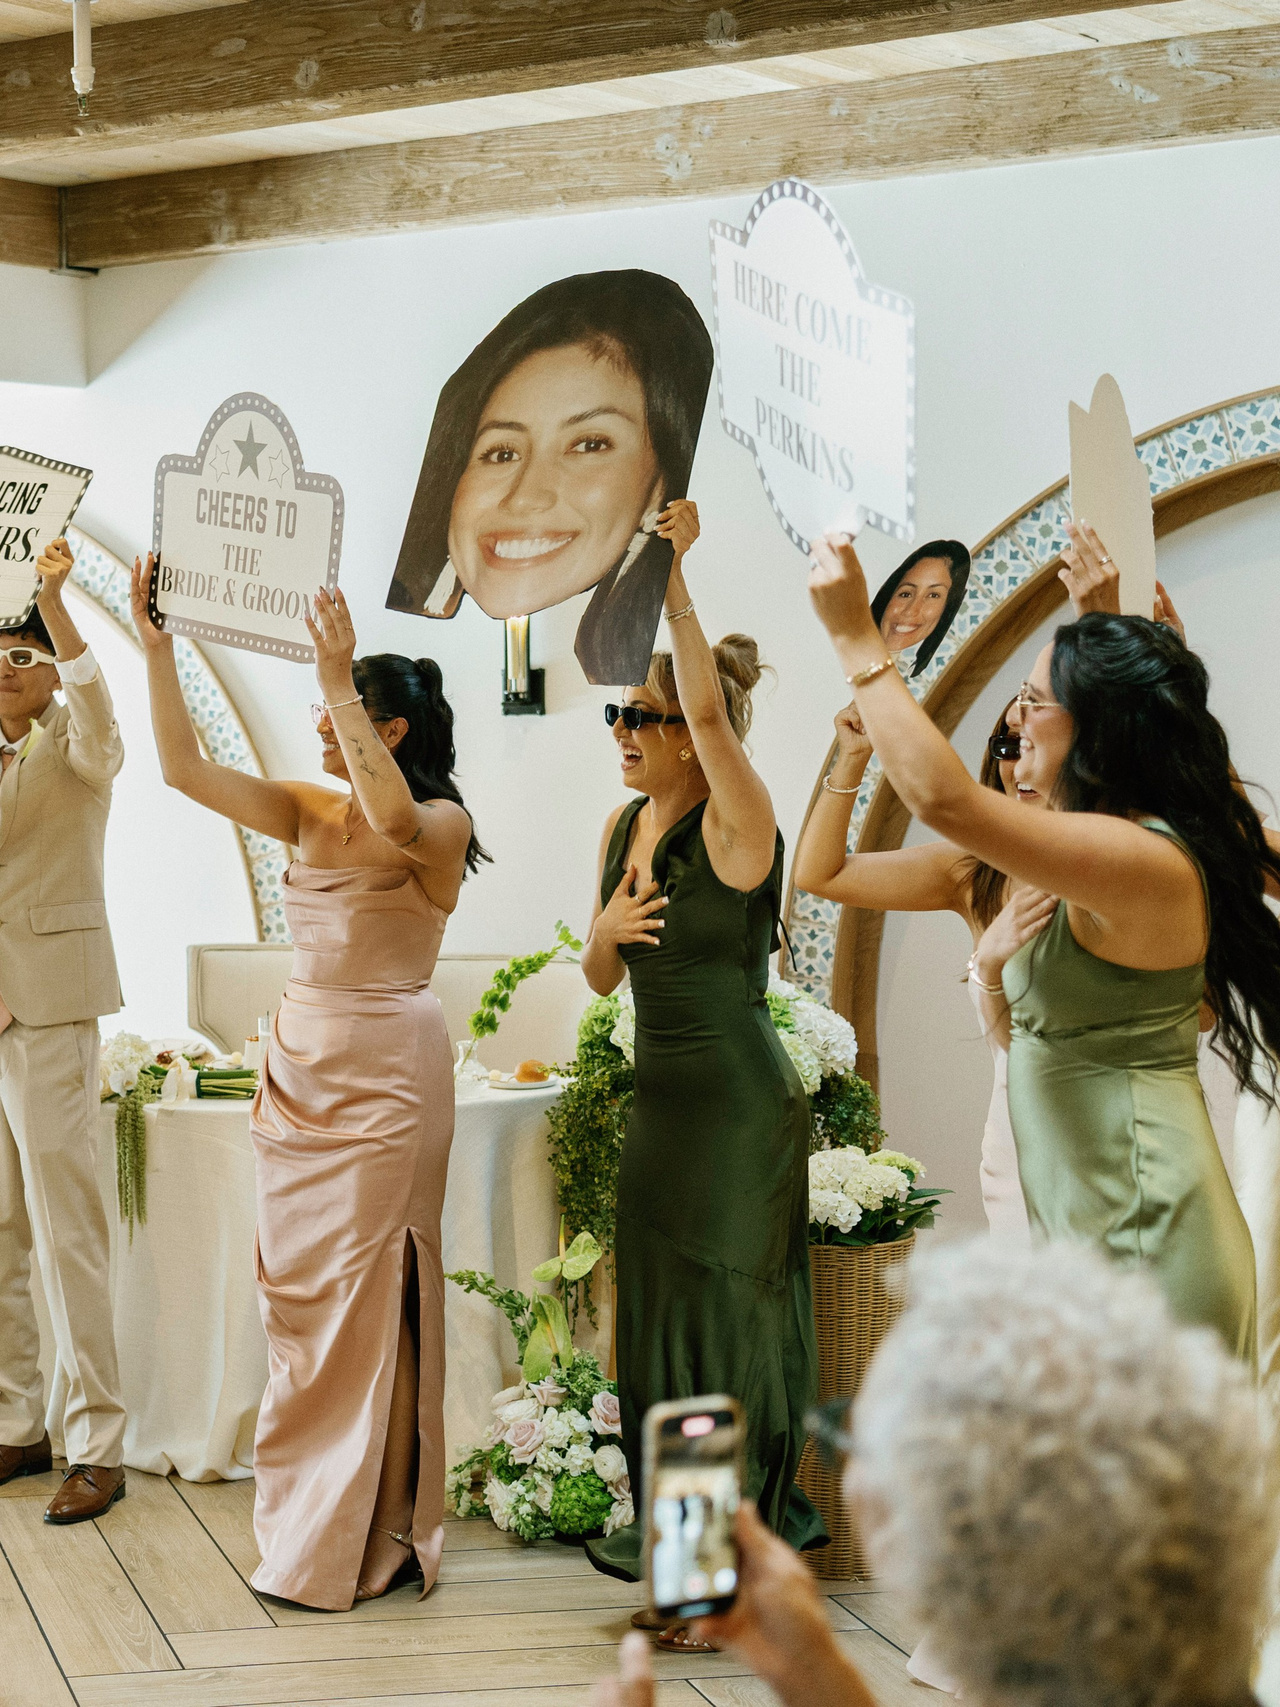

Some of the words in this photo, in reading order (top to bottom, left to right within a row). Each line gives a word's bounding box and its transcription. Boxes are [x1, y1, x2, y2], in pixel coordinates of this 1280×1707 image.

[734, 261, 787, 327] HERE
[795, 291, 871, 365] COME
[775, 344, 821, 408] THE
[754, 396, 855, 492] PERKINS
[196, 488, 268, 534] CHEERS
[275, 500, 297, 538] TO
[160, 565, 219, 603] BRIDE
[222, 578, 236, 606] &
[222, 543, 262, 577] THE
